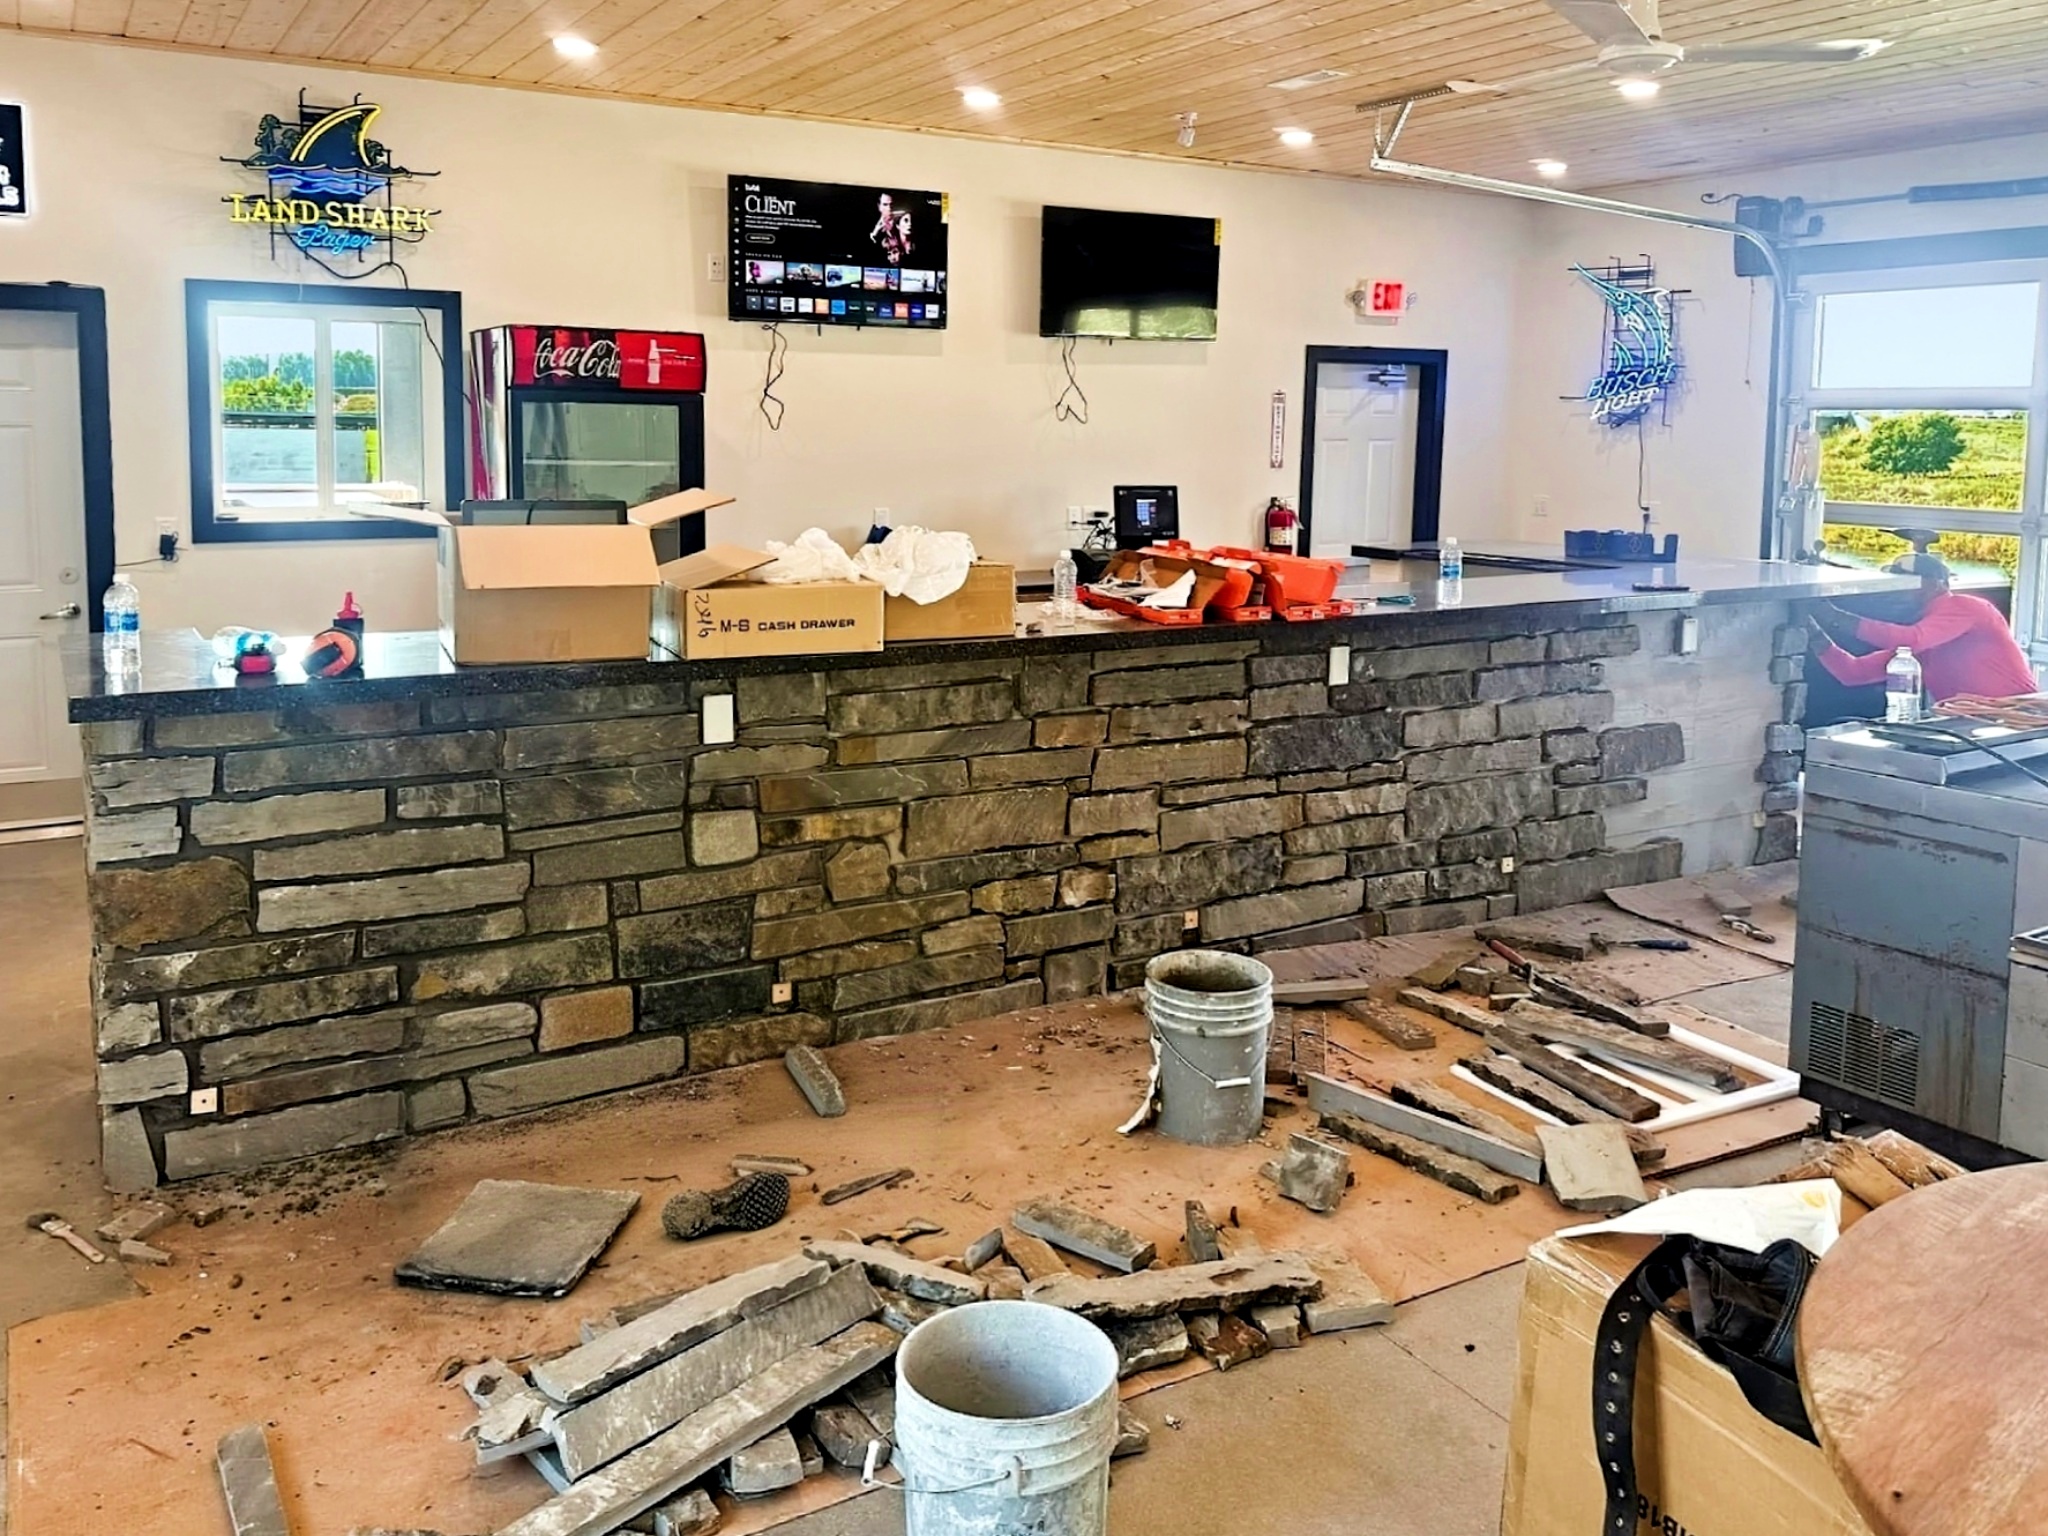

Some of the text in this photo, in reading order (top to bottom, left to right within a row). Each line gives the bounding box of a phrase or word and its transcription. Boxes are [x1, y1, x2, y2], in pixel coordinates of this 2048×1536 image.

[229, 193, 434, 233] LAND SHARK
[744, 194, 797, 216] CLIENT
[297, 223, 377, 254] Lager
[1585, 362, 1676, 402] BUSCH
[1589, 387, 1660, 420] LIGHT
[757, 621, 796, 632] CASH
[800, 618, 856, 630] DRAWER
